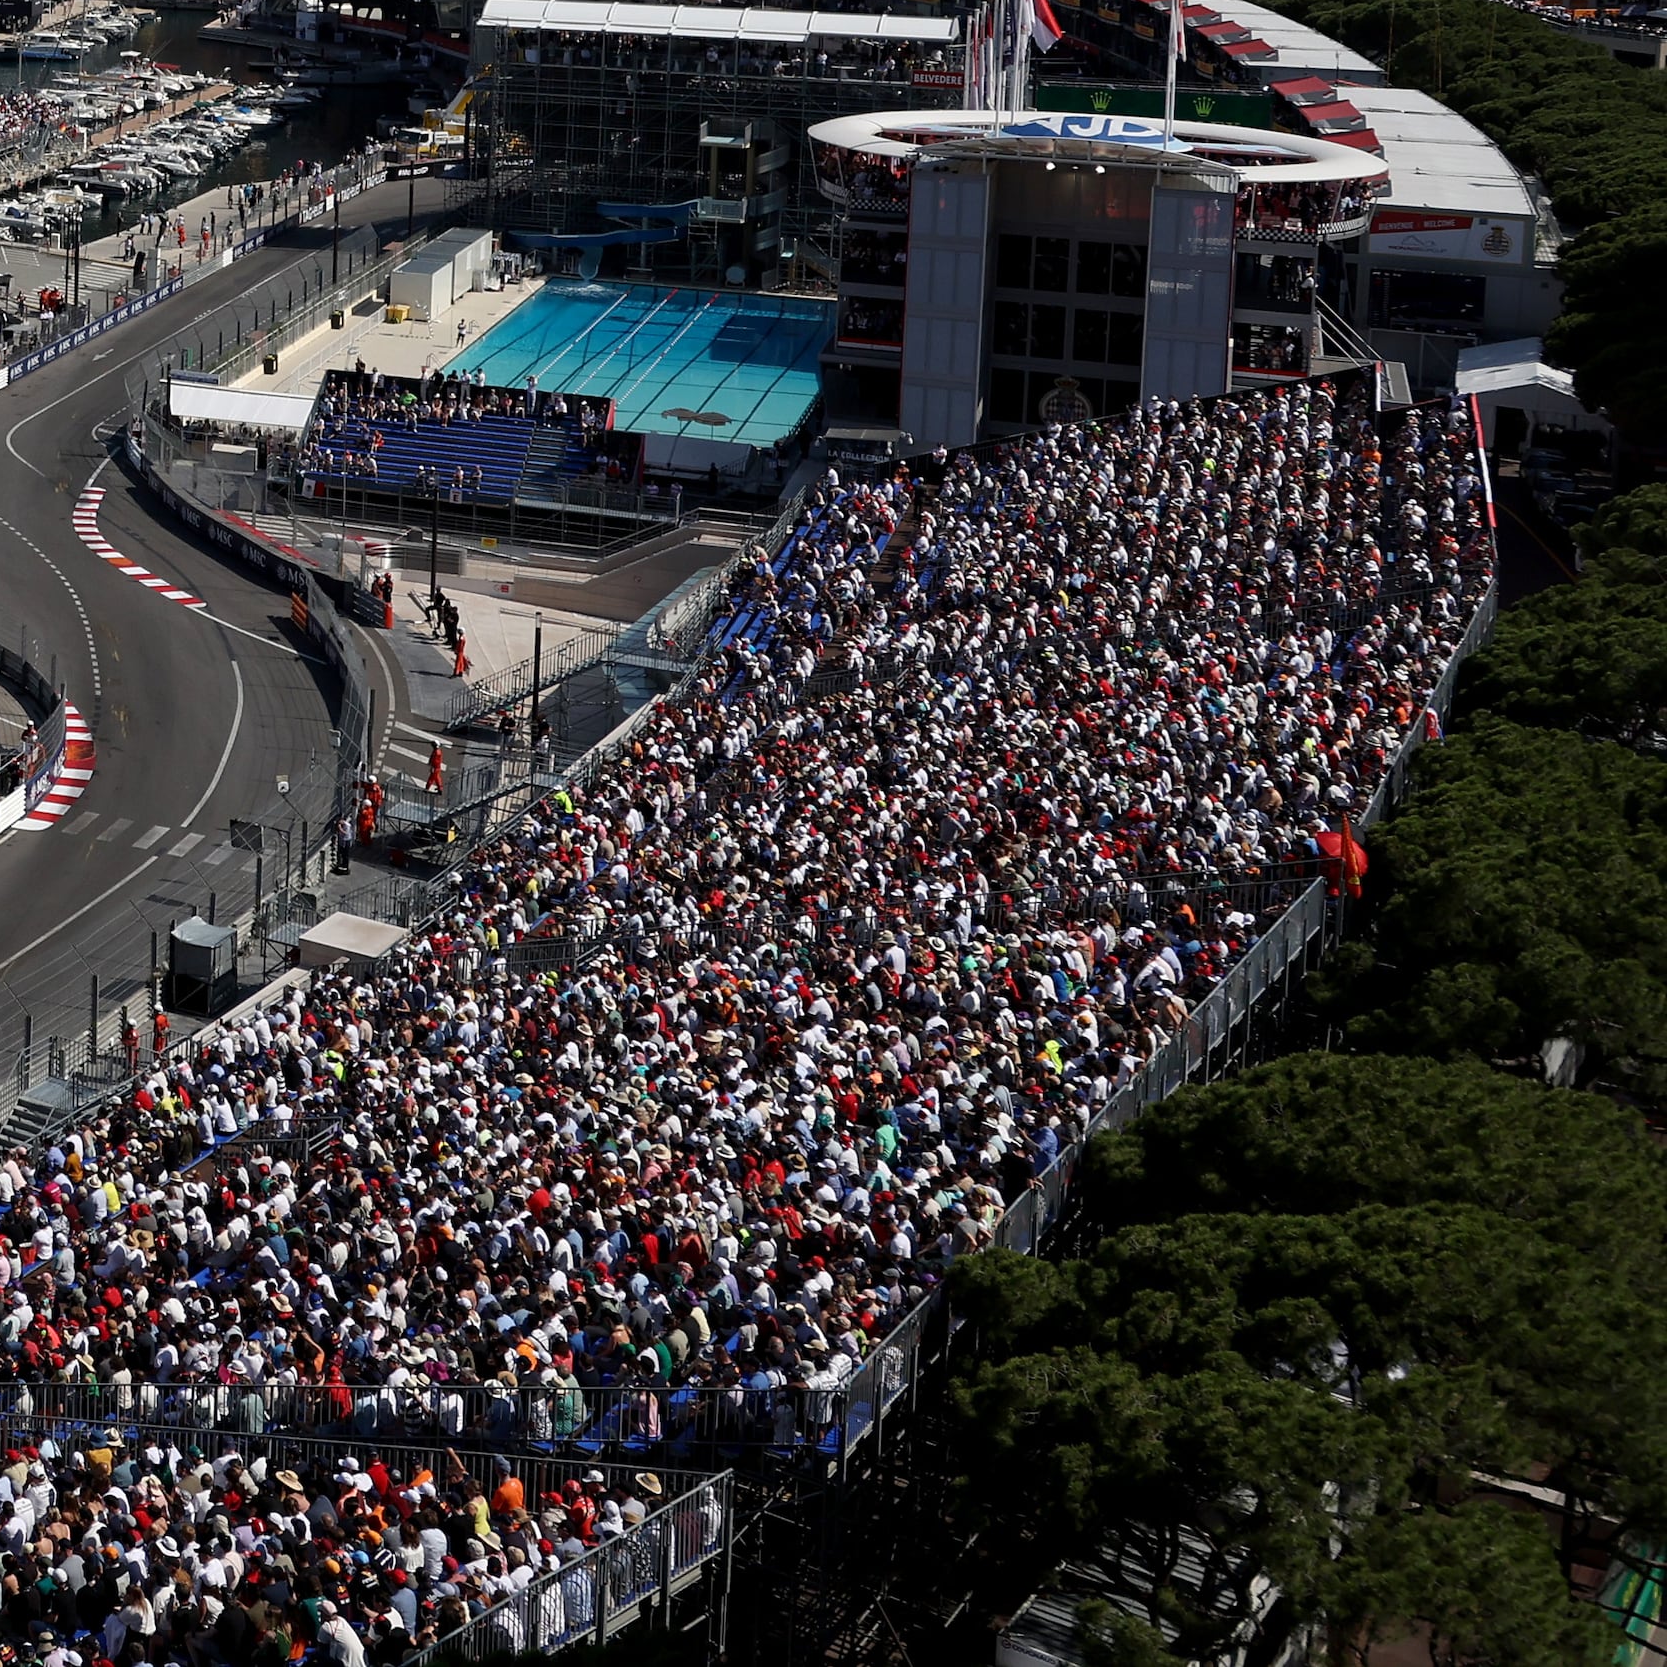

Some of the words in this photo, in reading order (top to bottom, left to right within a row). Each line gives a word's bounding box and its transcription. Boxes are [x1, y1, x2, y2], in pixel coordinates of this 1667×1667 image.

[913, 73, 963, 84] BELVEDERE
[217, 528, 234, 548] MSC
[248, 546, 267, 568] MSC
